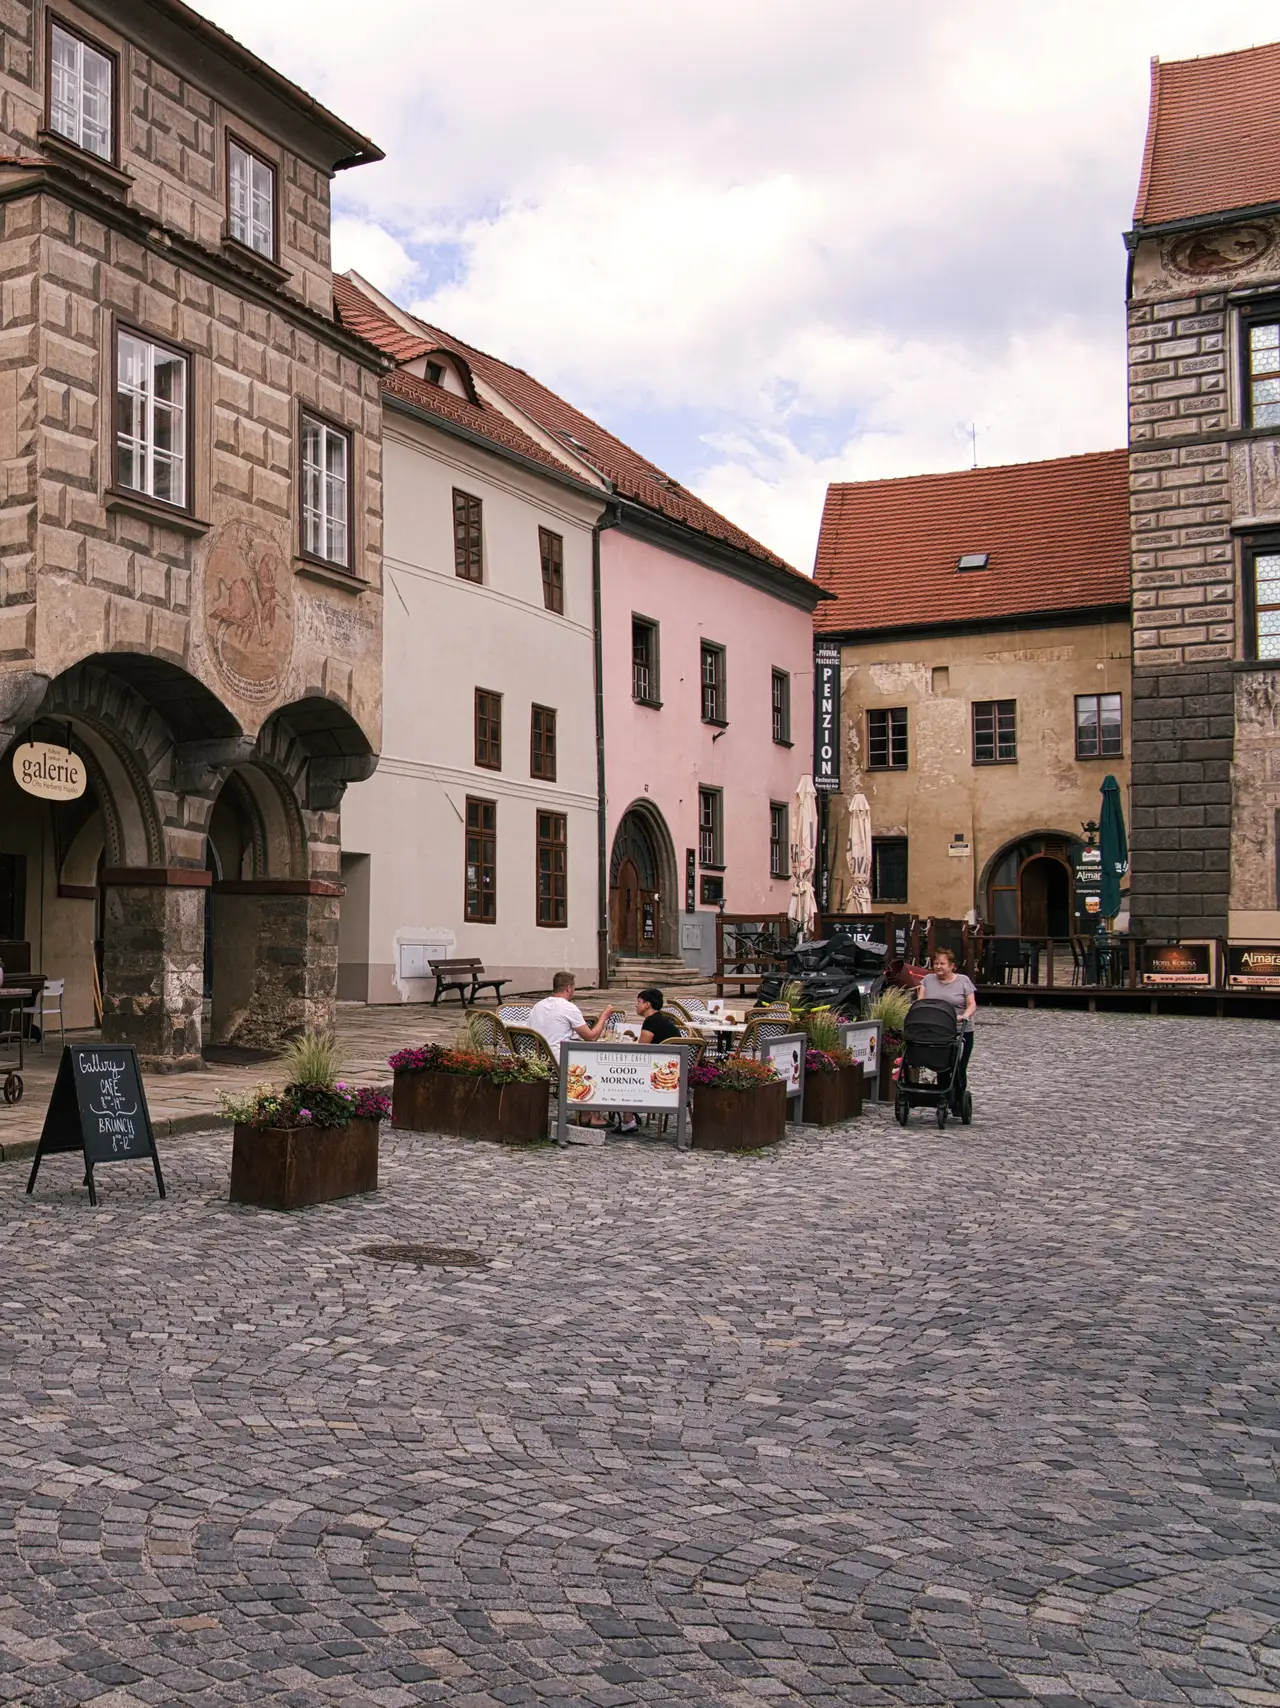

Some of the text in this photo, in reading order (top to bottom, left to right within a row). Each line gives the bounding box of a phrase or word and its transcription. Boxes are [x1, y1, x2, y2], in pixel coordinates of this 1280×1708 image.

[821, 667, 833, 775] PENZION
[22, 751, 78, 784] galerie
[1076, 870, 1102, 882] Almar
[599, 1052, 627, 1062] GALLERY
[78, 1053, 125, 1079] Gallery
[609, 1066, 637, 1075] GOOD
[600, 1076, 645, 1085] MORNING
[98, 1117, 135, 1135] BRUNCH
